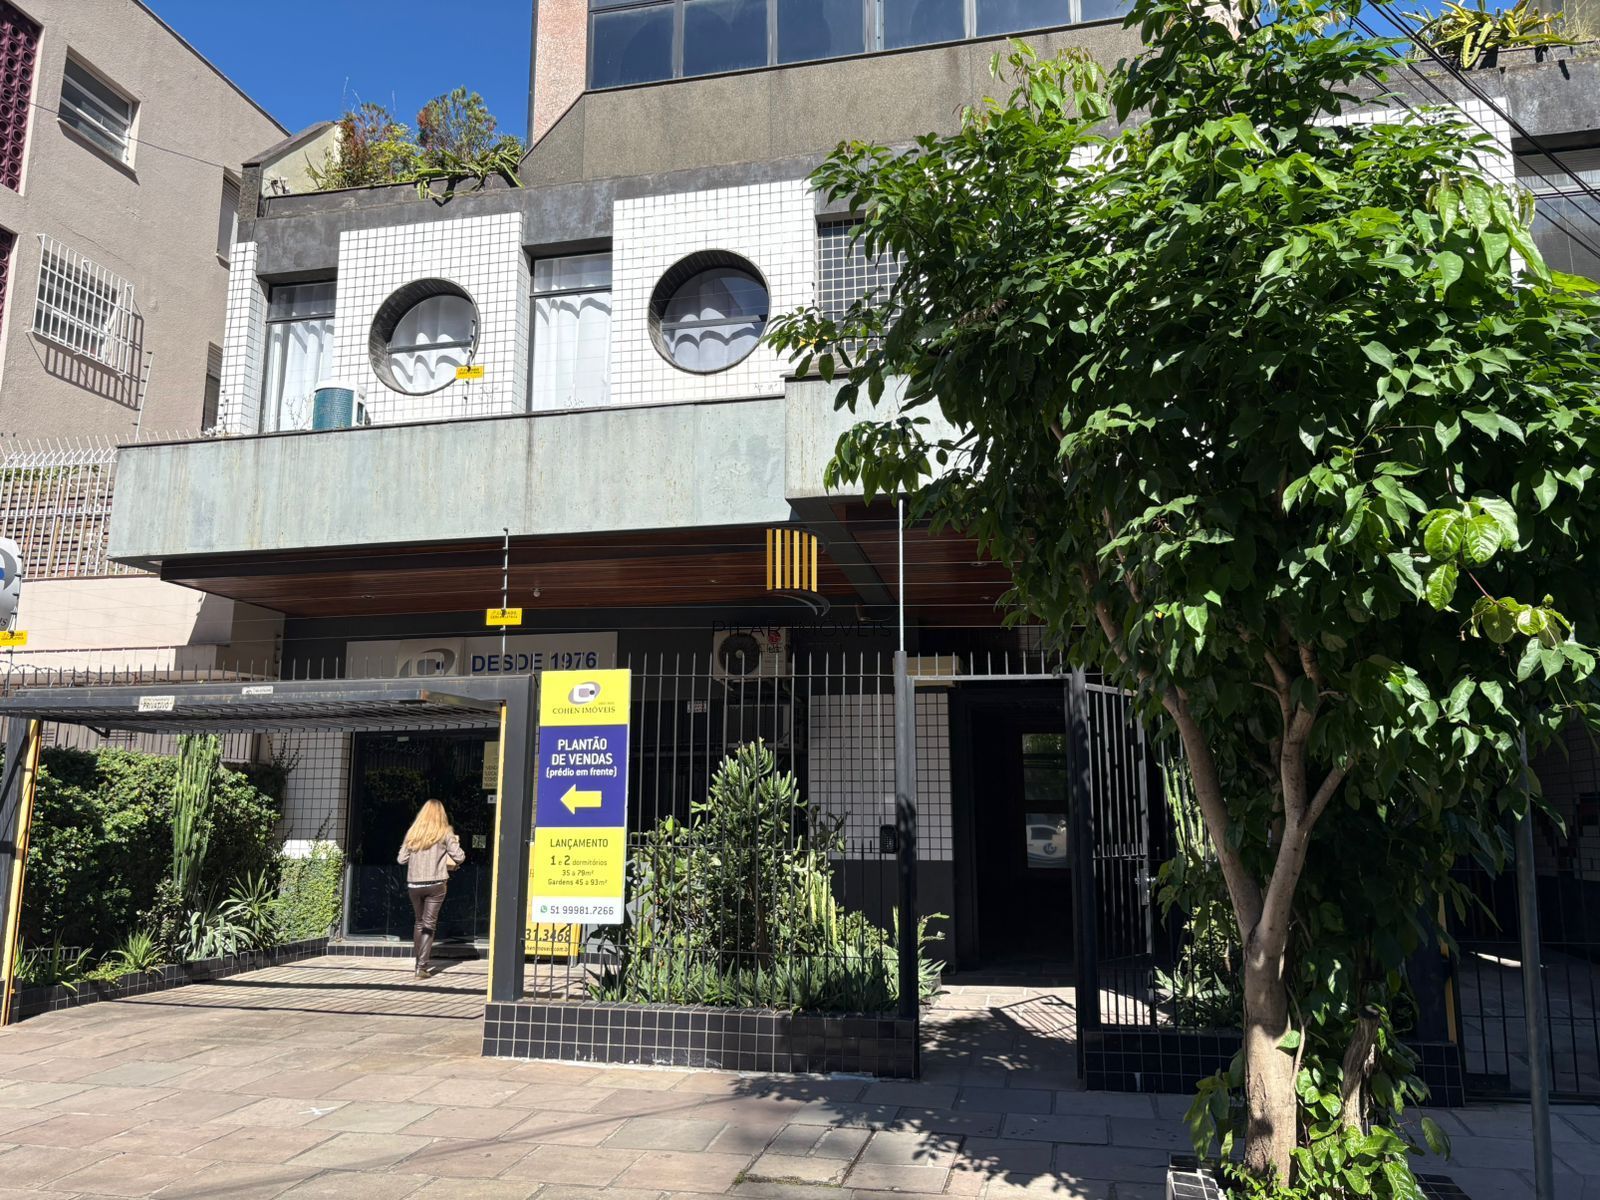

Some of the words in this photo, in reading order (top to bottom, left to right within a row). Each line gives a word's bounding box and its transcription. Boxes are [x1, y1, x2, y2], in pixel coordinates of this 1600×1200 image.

[472, 654, 542, 672] DESDE
[550, 652, 597, 670] 1976
[557, 736, 608, 751] PLANTÃO
[551, 754, 566, 766] DE
[568, 753, 613, 765] VENDAS
[545, 766, 575, 779] (prédio
[590, 766, 618, 778] frente)
[550, 839, 609, 850] LANÇAMENTO
[550, 855, 556, 866] 1
[564, 855, 571, 866] 2
[562, 869, 571, 877] 35
[548, 878, 574, 886] Gardens
[575, 878, 584, 886] 45
[591, 878, 608, 886] 93m²
[550, 905, 559, 915] 51
[563, 905, 614, 916] 99981.7266
